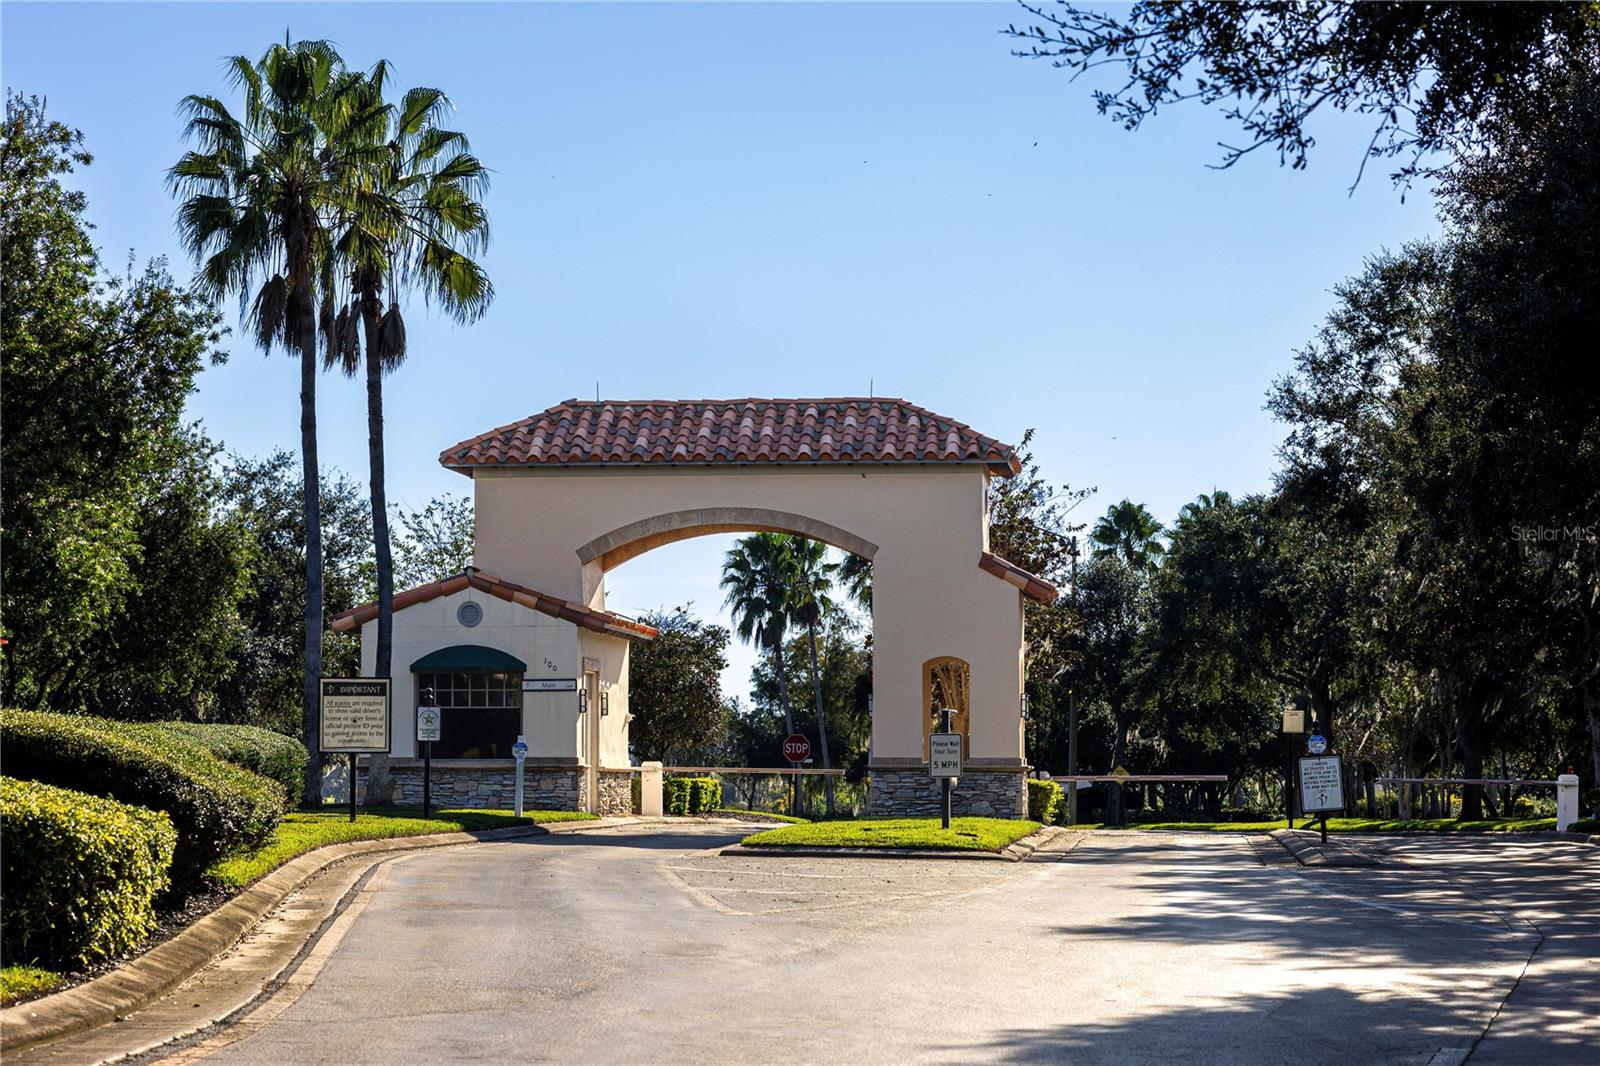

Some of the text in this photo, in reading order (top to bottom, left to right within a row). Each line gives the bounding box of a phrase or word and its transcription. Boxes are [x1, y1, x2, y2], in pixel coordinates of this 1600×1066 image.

[543, 657, 558, 672] 100
[785, 743, 808, 753] STOP
[933, 761, 939, 769] 5
